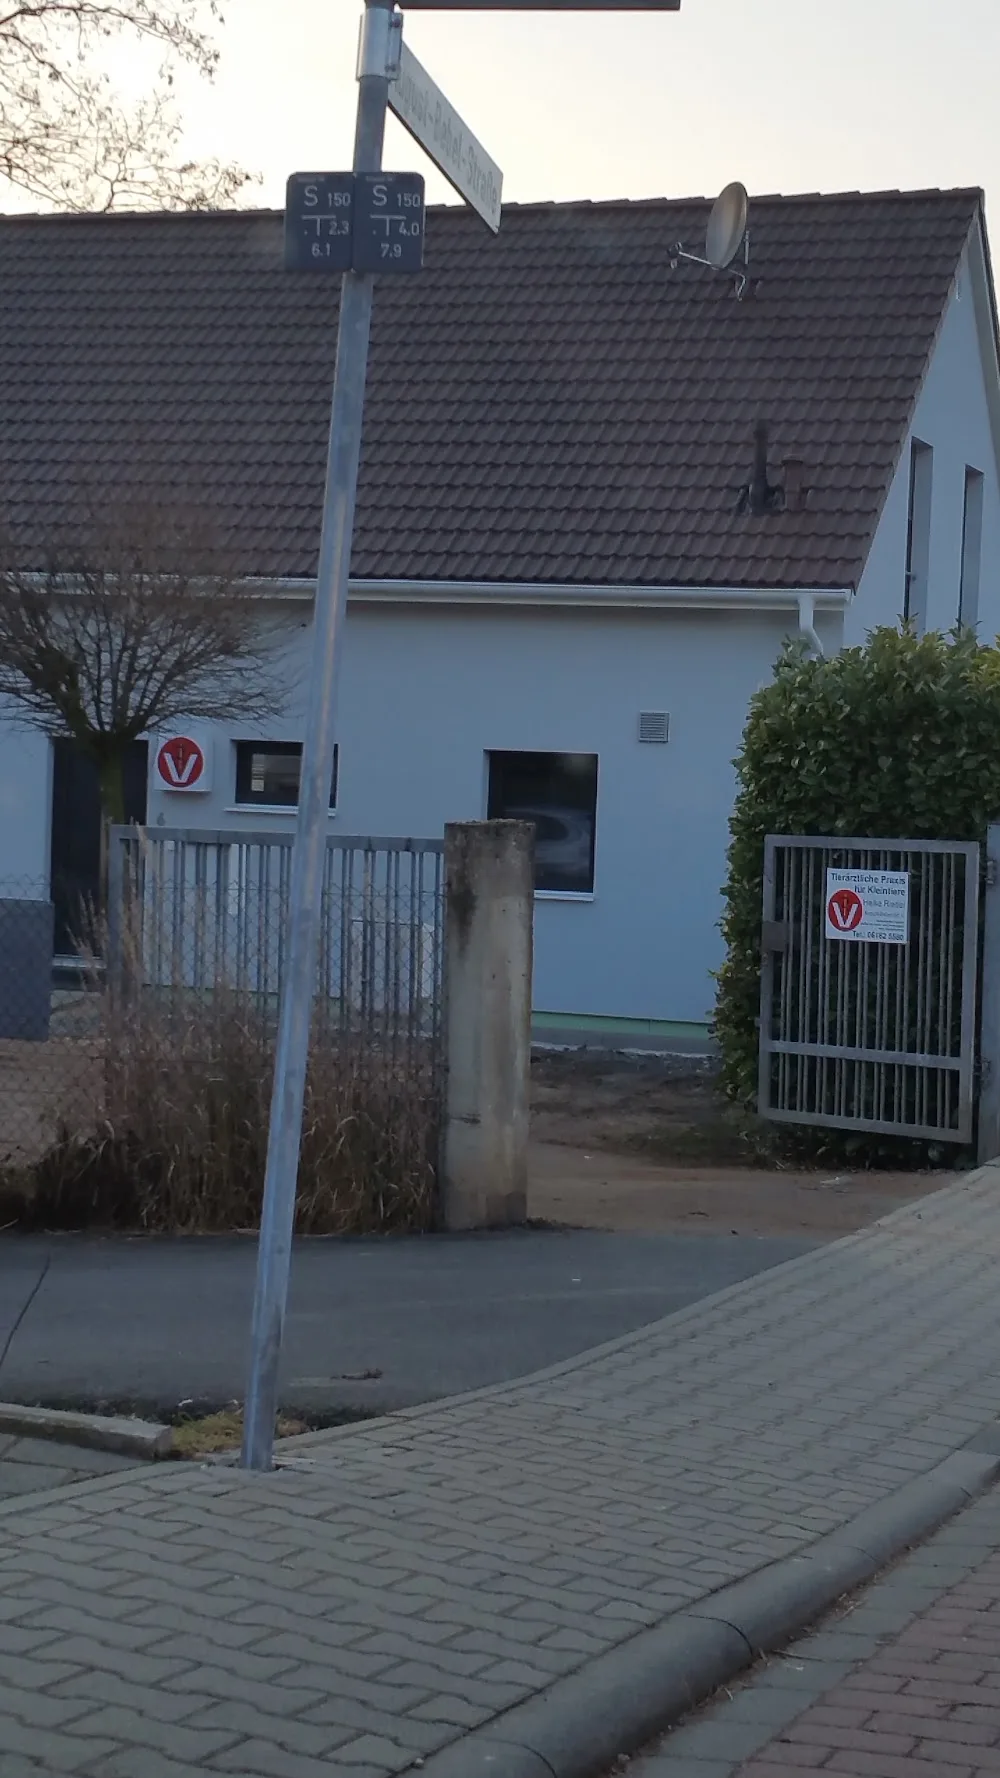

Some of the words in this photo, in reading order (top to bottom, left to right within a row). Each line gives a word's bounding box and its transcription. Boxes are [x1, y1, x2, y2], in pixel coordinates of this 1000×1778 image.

[304, 185, 318, 206] S
[328, 192, 351, 207] 150
[372, 185, 387, 206] S
[397, 193, 421, 208] 150
[329, 220, 349, 236] 2.3
[399, 222, 420, 236] 4.0
[311, 243, 331, 257] 6.1
[380, 243, 402, 258] 7.9
[831, 873, 879, 884] Tierärztliche
[881, 875, 906, 885] Praxis
[867, 885, 906, 896] Kleintiere
